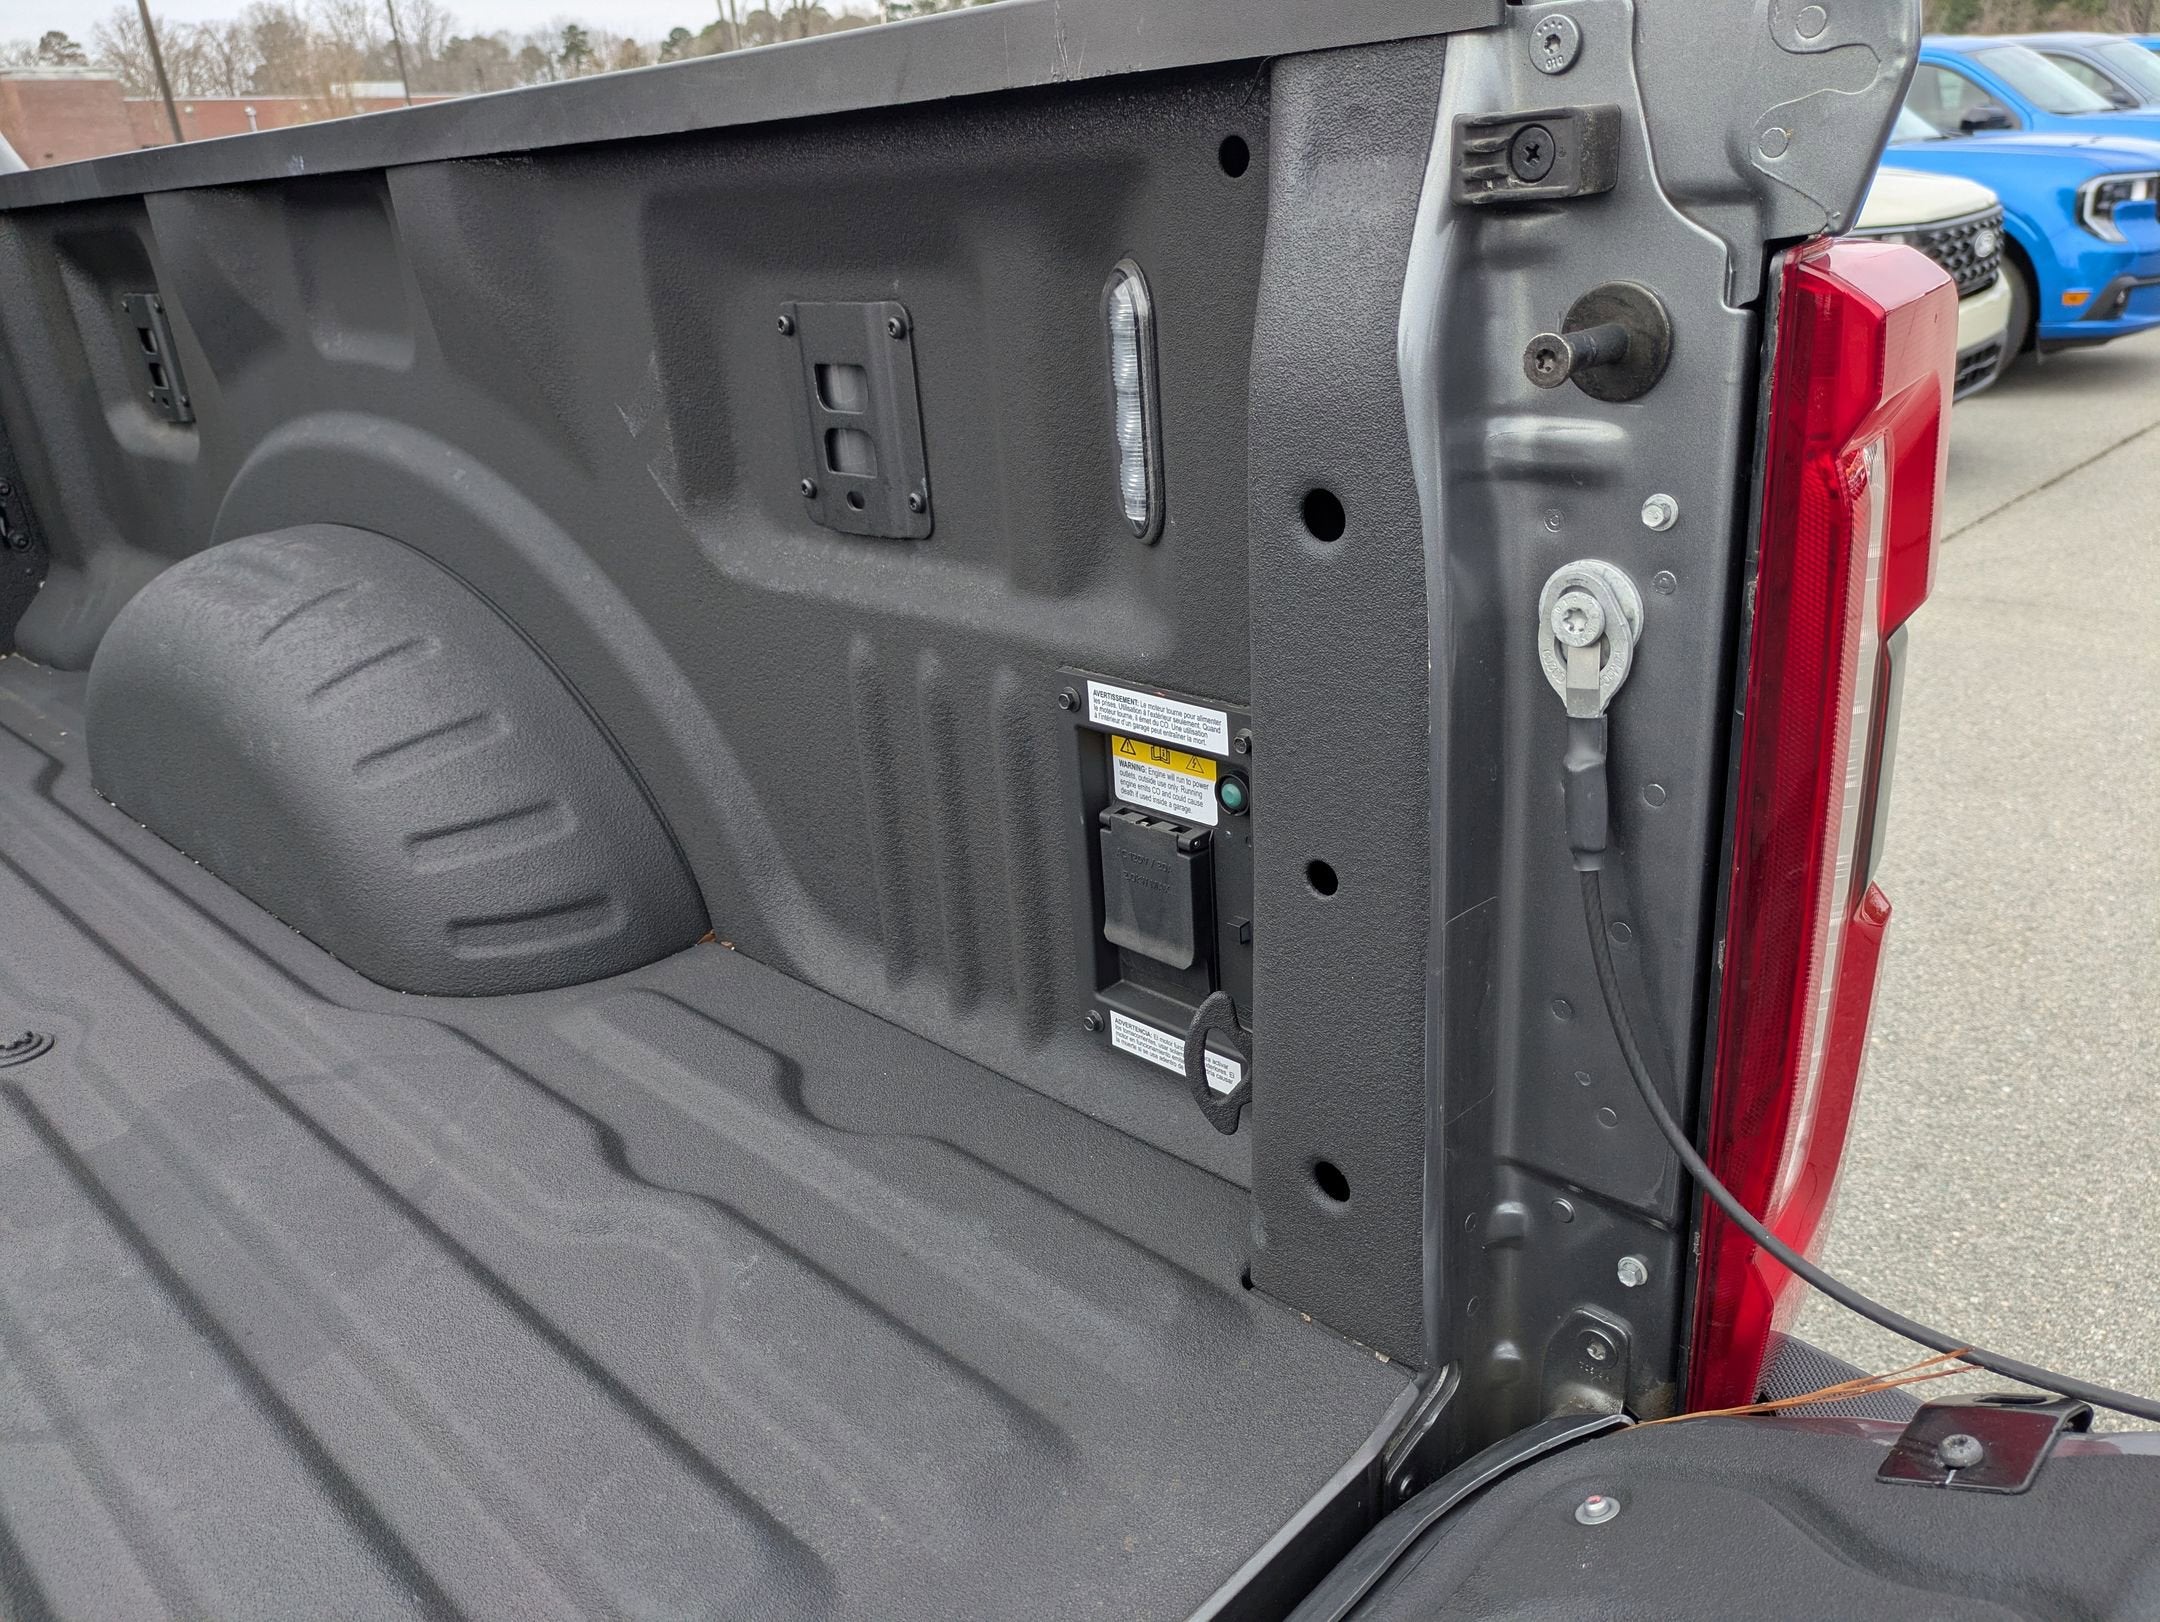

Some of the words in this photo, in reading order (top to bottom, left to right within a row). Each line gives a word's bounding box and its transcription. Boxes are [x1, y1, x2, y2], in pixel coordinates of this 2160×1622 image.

[1092, 688, 1139, 706] AVERTISSEMENT:
[1147, 702, 1165, 713] moteur
[1183, 711, 1196, 721] pour
[1196, 713, 1222, 726] alimenter
[1098, 705, 1116, 716] moteur
[1170, 722, 1182, 732] Une
[1182, 725, 1208, 739] utilisation
[1117, 702, 1142, 715] Utilisation
[1202, 722, 1221, 734] Quand
[1132, 722, 1149, 733] garage
[1150, 725, 1162, 736] peut
[1118, 759, 1147, 774] WARNING:
[1147, 767, 1166, 780] Engine
[1192, 780, 1209, 791] power
[1137, 773, 1156, 786] outside
[1156, 780, 1167, 789] use
[1180, 784, 1202, 800] Running
[1119, 777, 1136, 790] engine
[1160, 788, 1171, 798] and
[1171, 792, 1186, 803] could
[1186, 797, 1203, 808] cause
[1119, 785, 1134, 797] death
[1138, 791, 1152, 802] used
[1114, 1016, 1152, 1038] ADVERTENCIA:
